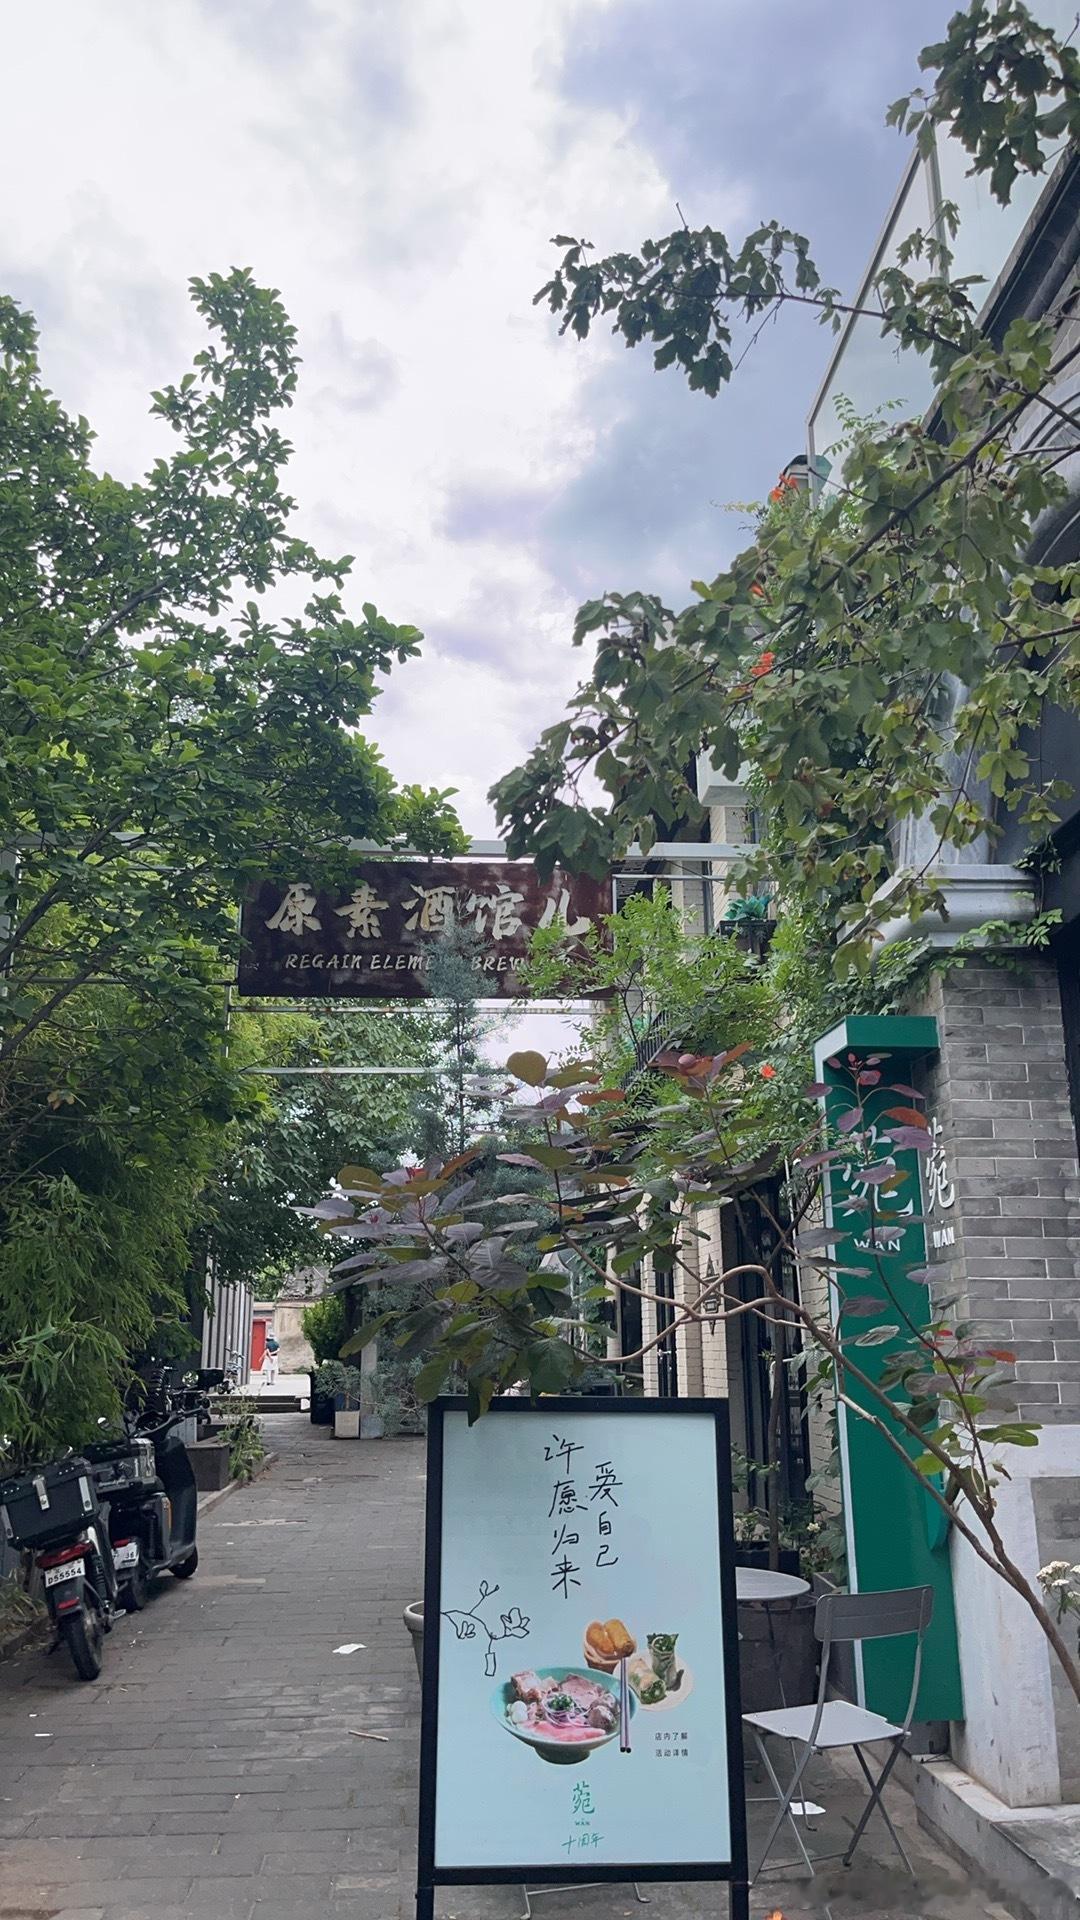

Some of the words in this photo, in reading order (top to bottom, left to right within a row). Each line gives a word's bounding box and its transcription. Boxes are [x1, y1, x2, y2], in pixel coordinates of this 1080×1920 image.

[285, 954, 362, 969] REGAIN
[544, 1434, 588, 1599] 许愿归来
[589, 1461, 623, 1567] 爱自己
[572, 1780, 595, 1814] 苑
[561, 1832, 605, 1855] 十周年
